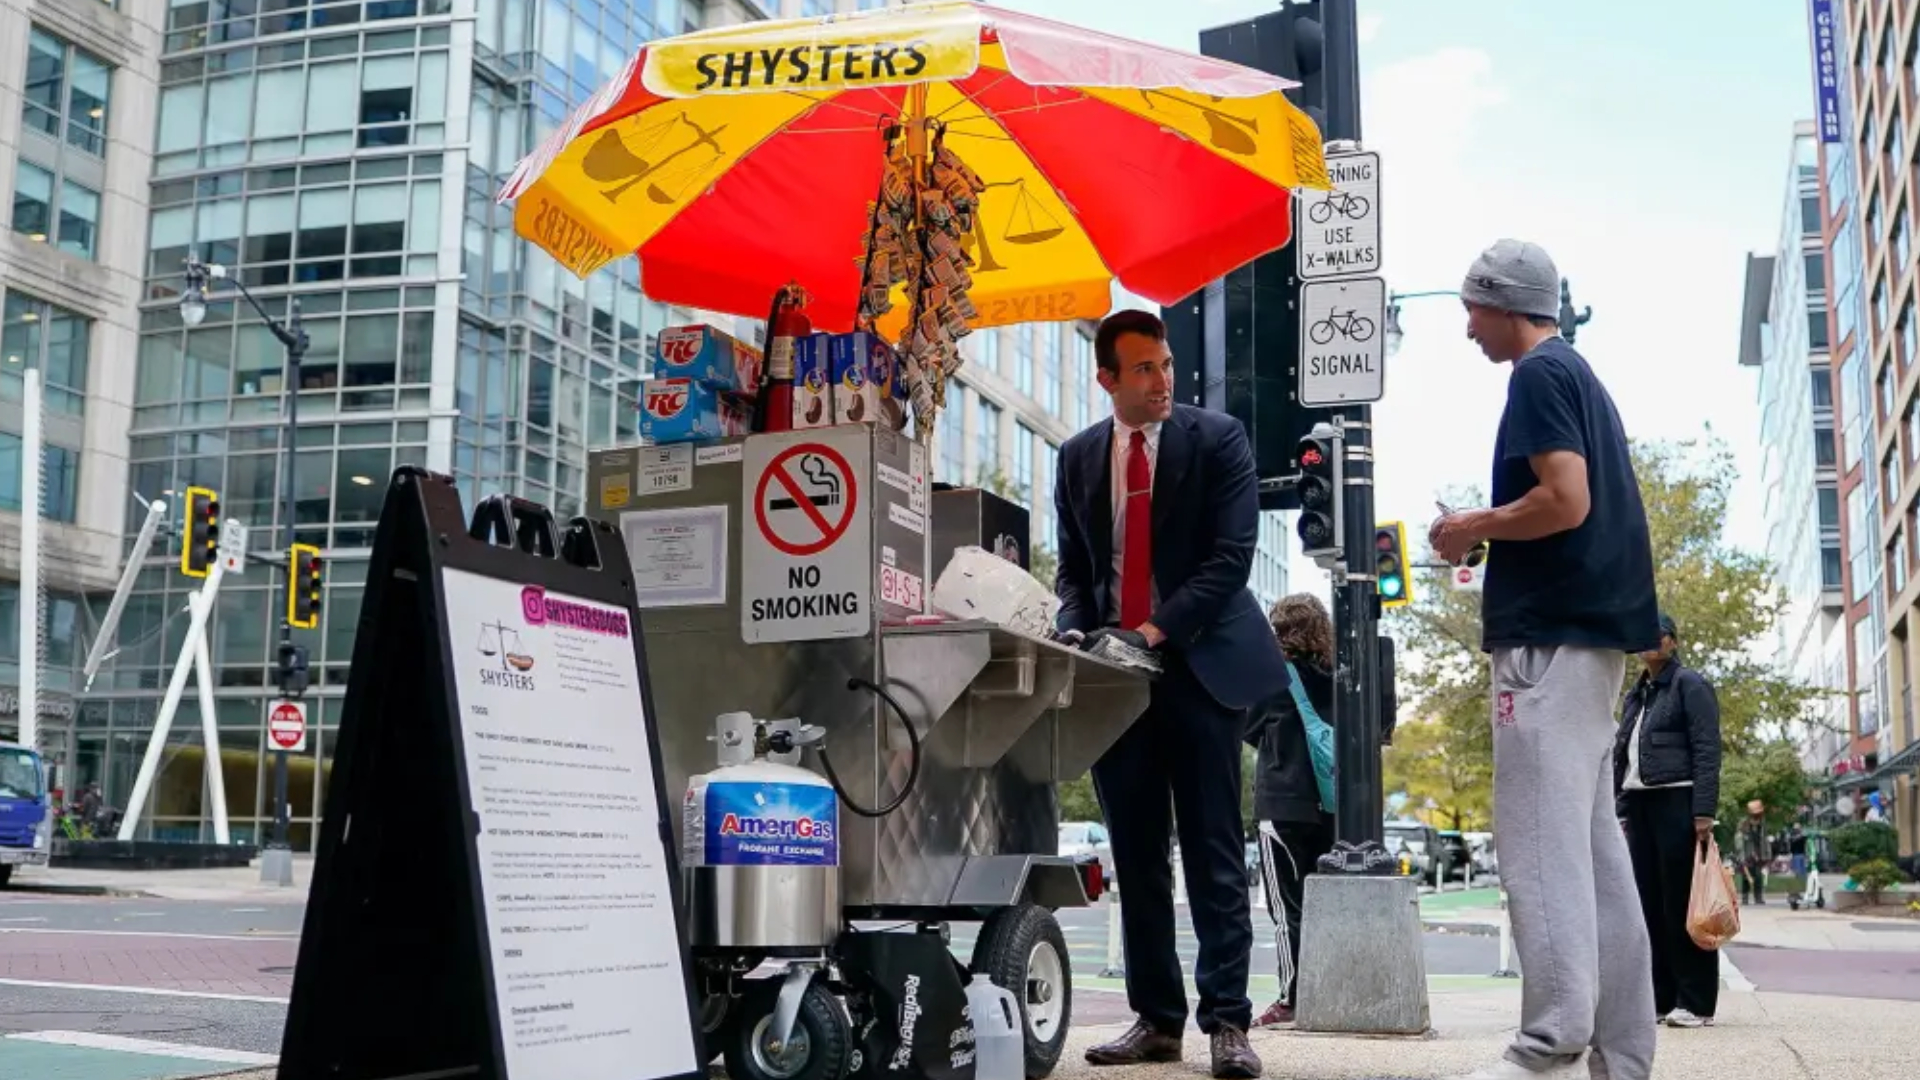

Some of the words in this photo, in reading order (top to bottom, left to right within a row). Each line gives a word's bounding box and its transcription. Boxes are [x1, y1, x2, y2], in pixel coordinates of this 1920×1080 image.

[1817, 11, 1835, 87] Garden
[696, 41, 927, 90] SHYSTERS
[1825, 98, 1838, 136] Inn
[1328, 164, 1371, 183] RNING
[1324, 227, 1354, 244] USE
[1306, 248, 1374, 269] X-WALKS
[1310, 354, 1374, 376] SIGNAL
[648, 394, 684, 417] RC
[788, 565, 821, 589] NO
[751, 591, 858, 621] SMOKING
[479, 668, 536, 692] SHYSTERS
[720, 813, 834, 840] AmeriGas
[783, 845, 825, 856] EXCHANGE
